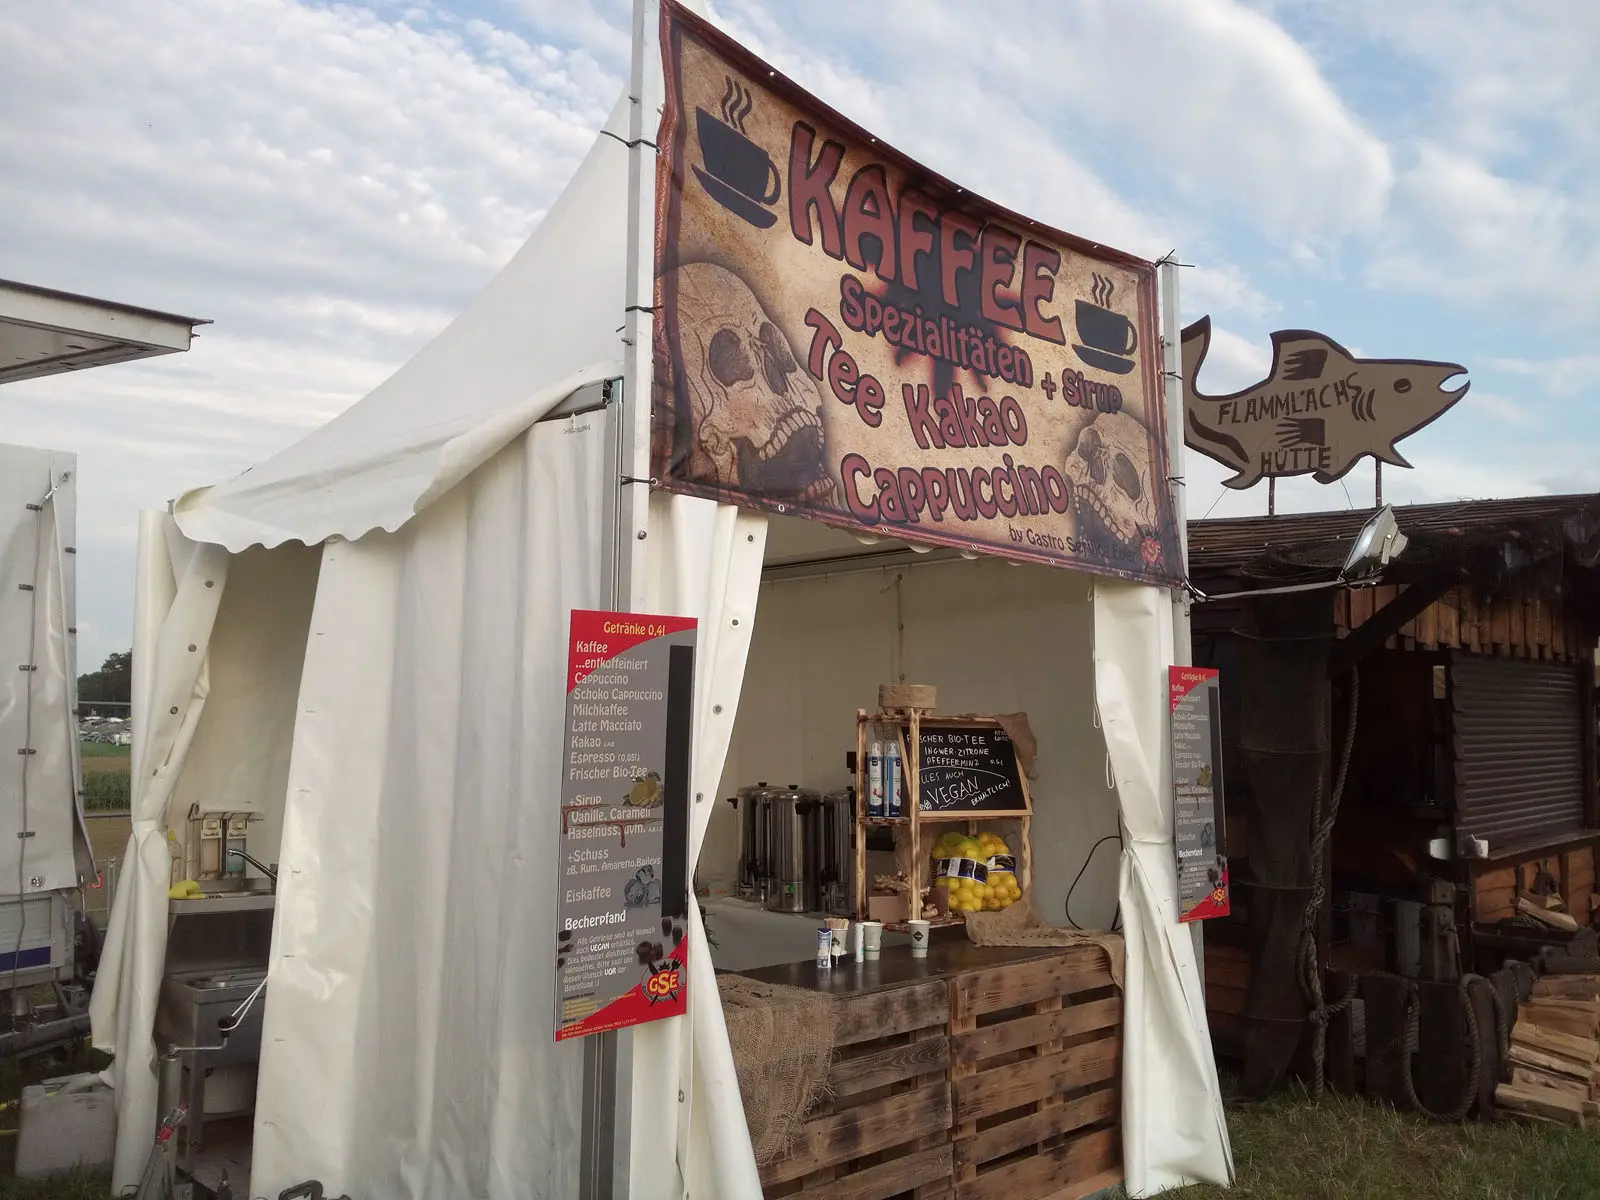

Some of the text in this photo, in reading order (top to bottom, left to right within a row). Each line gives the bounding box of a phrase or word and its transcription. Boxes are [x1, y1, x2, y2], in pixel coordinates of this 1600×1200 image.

[788, 120, 1065, 345] KAFFEE
[840, 273, 1033, 388] Spezialitäten
[804, 307, 885, 428] Tee
[1062, 368, 1123, 414] Sirup
[902, 383, 1027, 449] Kakao
[1260, 447, 1331, 472] HÜTTE
[840, 453, 1069, 525] Cappuccino
[1009, 524, 1023, 542] by
[1026, 529, 1065, 551] Gastro
[603, 621, 646, 635] Getränke
[576, 640, 608, 653] Kaffee
[574, 672, 629, 685] Cappuccino
[573, 687, 663, 701] Schoko Cappuccino
[573, 703, 629, 716] Milchkaffee
[572, 720, 642, 732] Latte Macciato
[571, 736, 602, 749] Kakao
[570, 751, 616, 764] Espresso
[926, 756, 980, 767] PFEFFERMINZ
[570, 765, 648, 781] Frischer Bio-Tee
[920, 770, 964, 784] LLES AUCH
[926, 776, 979, 804] VEGAN
[566, 886, 612, 903] Eiskaffee
[565, 909, 626, 931] Becherpfand
[590, 942, 610, 952] VEGAN
[604, 967, 617, 976] VOR
[649, 972, 677, 994] GSE
